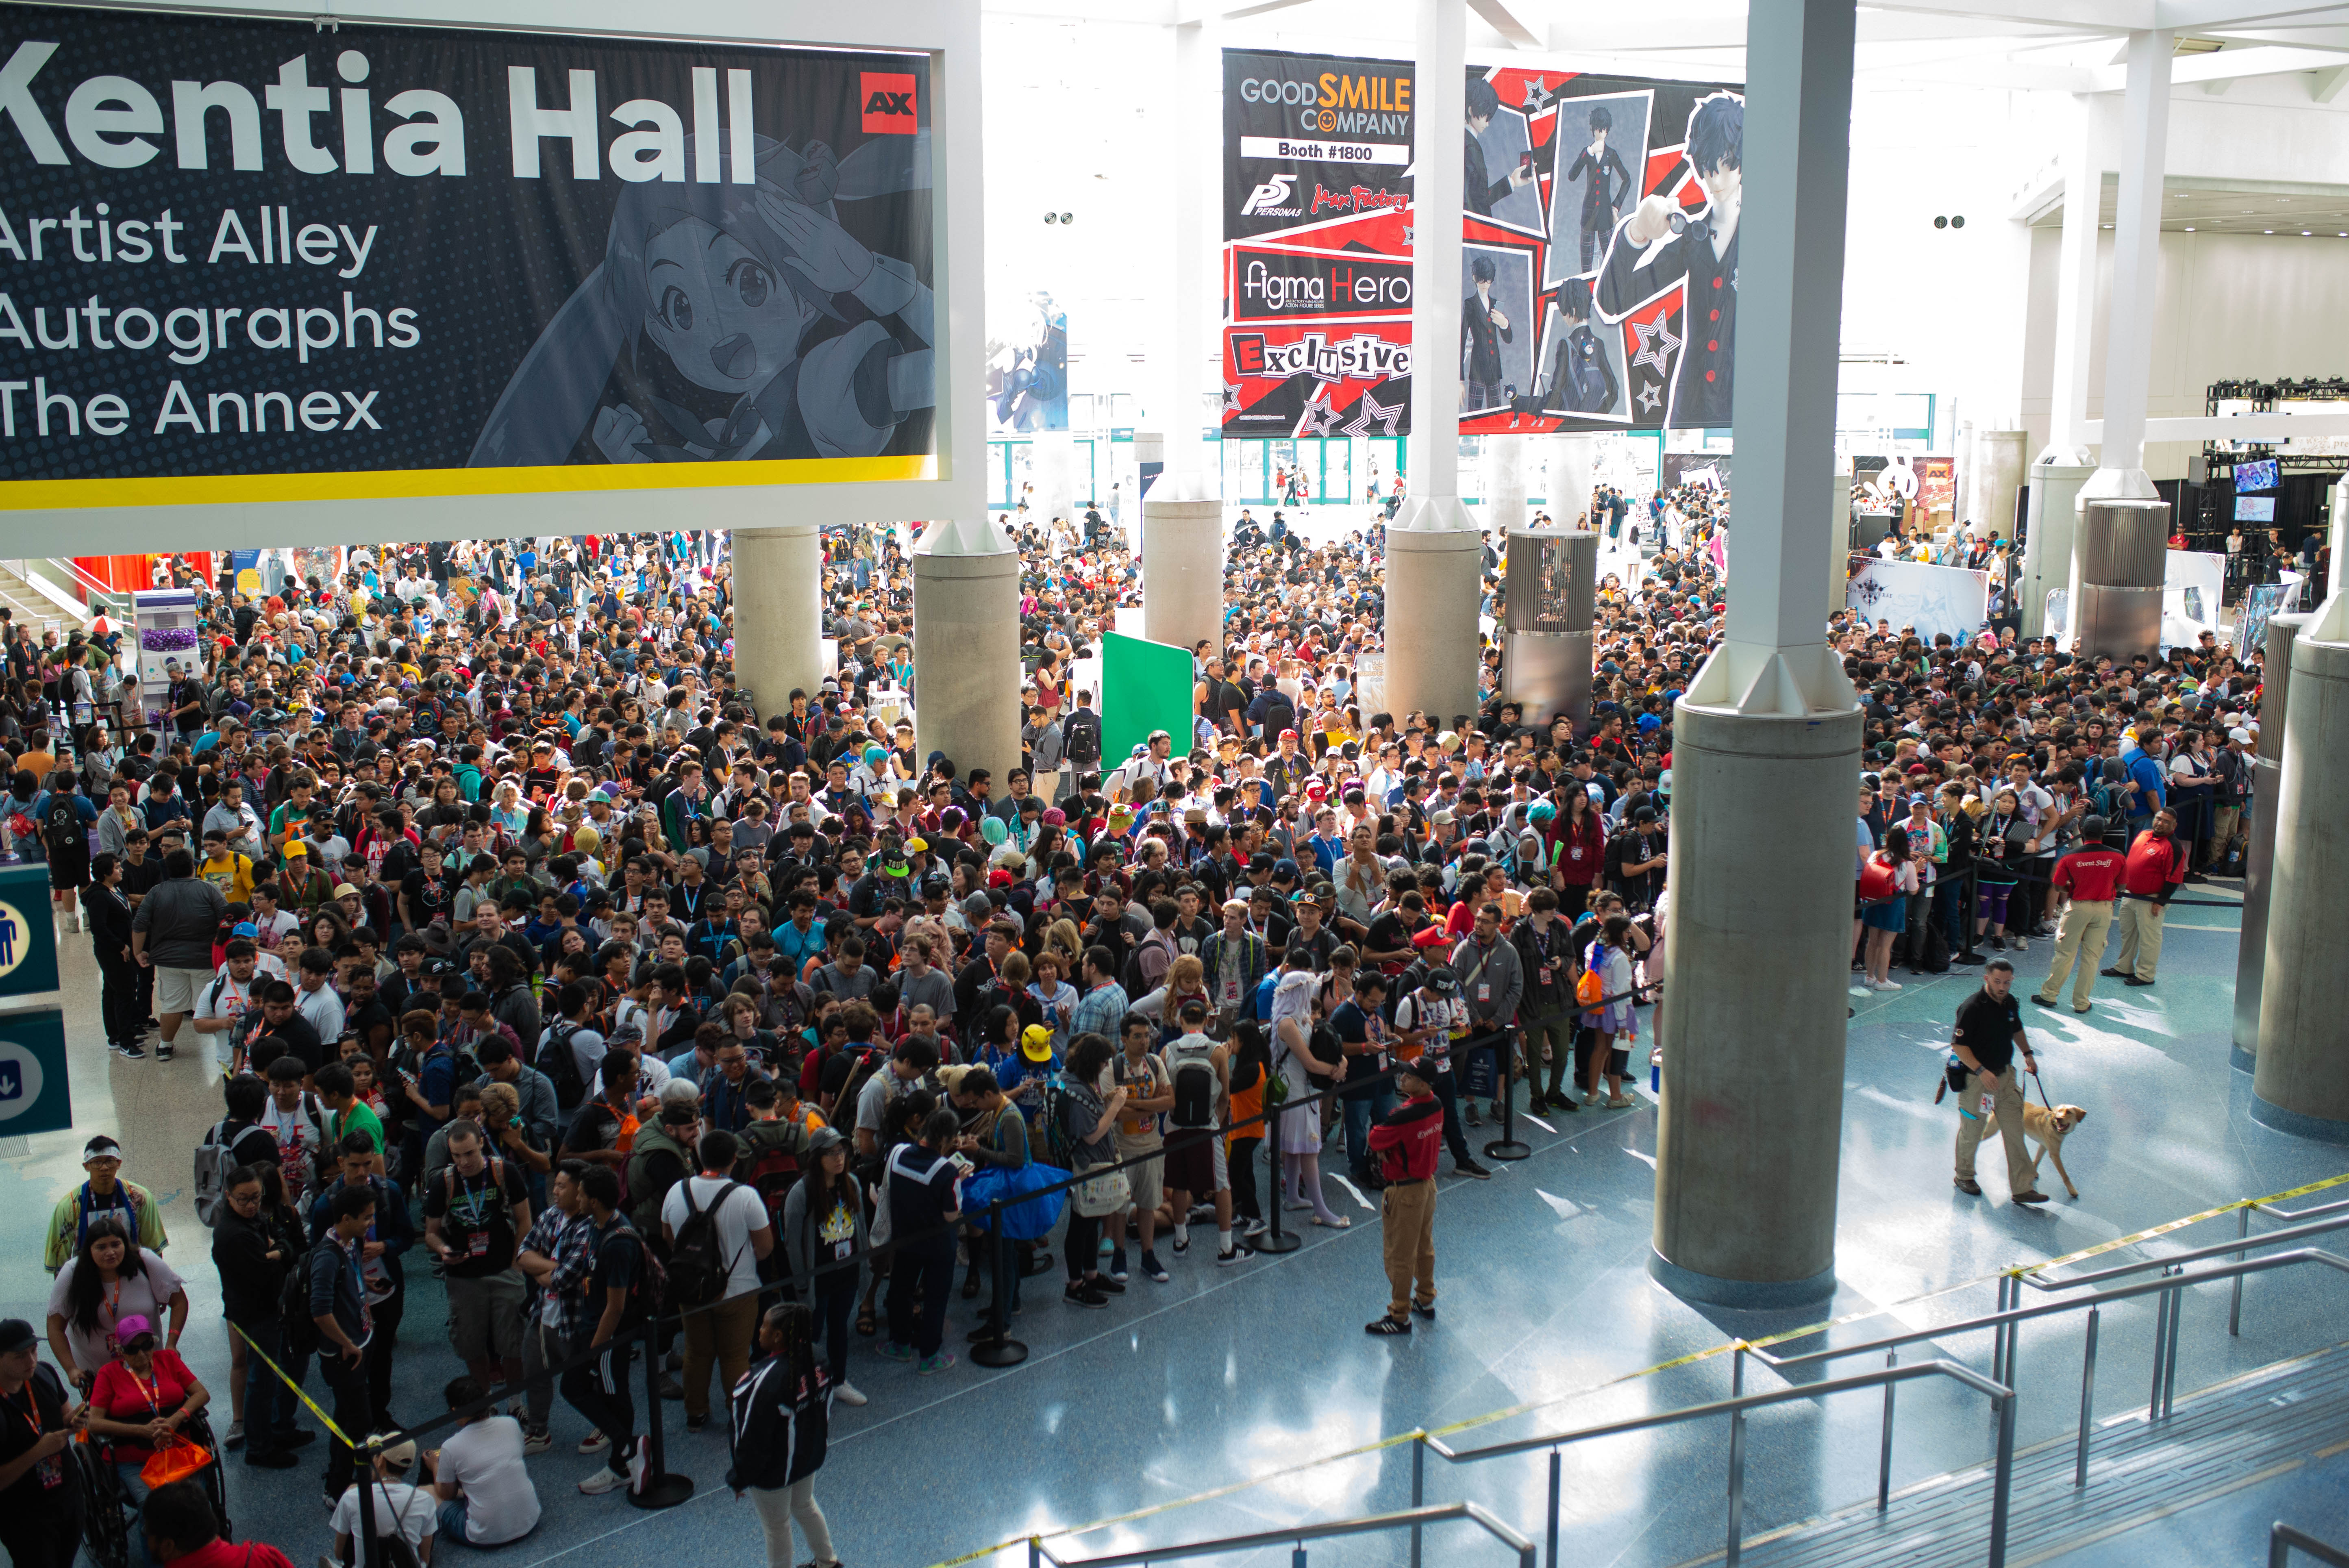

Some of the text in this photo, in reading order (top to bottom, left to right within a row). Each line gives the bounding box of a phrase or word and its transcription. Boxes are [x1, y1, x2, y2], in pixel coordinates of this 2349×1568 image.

[863, 91, 915, 116] AX
[1240, 72, 1410, 112] GOOD SMILE
[507, 65, 755, 185] Hall
[1301, 109, 1409, 136] COMPANY
[1279, 142, 1372, 161] Booth #1800
[1310, 183, 1409, 215] Max Factory
[0, 202, 378, 279] Artist Alley
[1244, 260, 1411, 310] figma Hero
[0, 291, 421, 365] Autographs
[1239, 338, 1409, 375] Exclusive
[0, 376, 383, 437] The Annex
[1928, 470, 1947, 478] AX
[2095, 859, 2112, 868] Staff
[1417, 1126, 1433, 1139] Event
